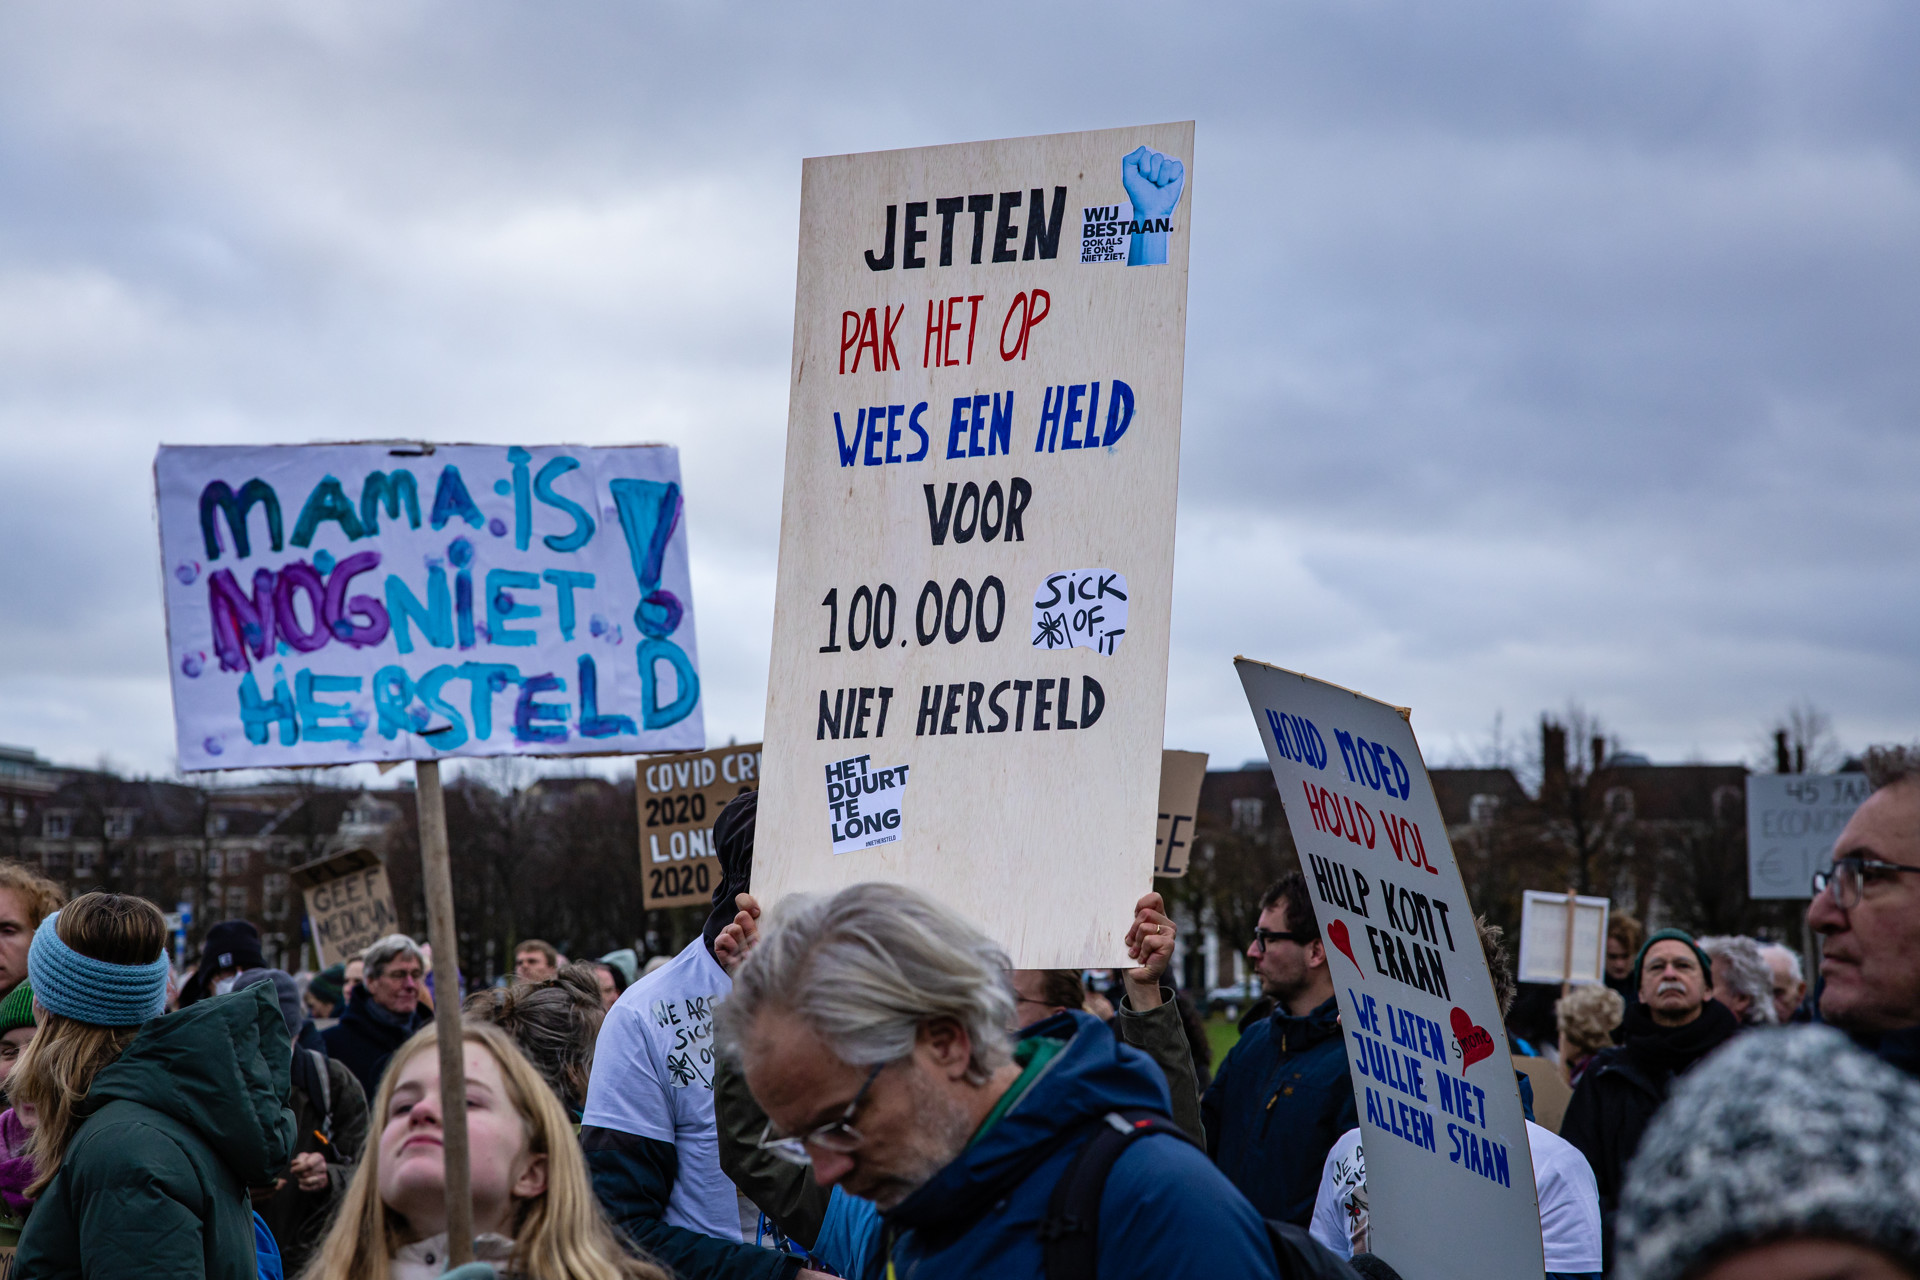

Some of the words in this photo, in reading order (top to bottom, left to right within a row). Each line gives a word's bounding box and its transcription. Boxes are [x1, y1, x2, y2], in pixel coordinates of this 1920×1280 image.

[864, 185, 1067, 271] JETTEN
[1083, 218, 1174, 238] BESTAAN.
[1084, 206, 1119, 222] WIJ
[1081, 254, 1102, 262] NIET
[1104, 252, 1125, 260] ZIET.
[1082, 239, 1104, 247] OOK
[1105, 237, 1123, 246] ALS
[1082, 247, 1092, 255] JE
[1094, 246, 1114, 254] ONS
[839, 302, 905, 375] PAK
[923, 294, 984, 368] HET
[1000, 288, 1051, 362] OP
[833, 401, 929, 468] WEES
[946, 390, 1014, 460] EEN
[1035, 379, 1135, 454] HELD
[198, 464, 485, 562] MAMA
[923, 476, 1033, 546] VOOR
[208, 551, 391, 673] NOG
[818, 575, 1006, 653] 100.000
[1073, 605, 1105, 637] OF
[237, 638, 700, 752] HERSTELD
[816, 686, 894, 741] NIET
[915, 675, 1106, 737] HERSTELD
[645, 757, 716, 793] COVID
[825, 754, 871, 784] HET
[1265, 708, 1328, 771] HOUD
[1333, 728, 1410, 801] MOED
[827, 764, 909, 803] DUURT
[1785, 781, 1819, 805] 45
[646, 793, 706, 827] 2020
[829, 798, 860, 822] TE
[832, 808, 901, 843] LONG
[1302, 780, 1376, 850] HOUD
[1379, 810, 1438, 875] VOL
[313, 868, 380, 912] GEEF
[650, 863, 710, 899] 2020
[1308, 853, 1370, 918] HULP
[1380, 879, 1455, 952] KOMT
[1365, 924, 1451, 1002] ERAAN
[650, 1000, 681, 1028] WE
[1348, 988, 1382, 1037] WE
[1386, 1003, 1447, 1066] LATEN
[1351, 1030, 1428, 1103] JULLIE
[1436, 1069, 1486, 1130] NIET
[1365, 1086, 1436, 1154] ALLEEN
[1447, 1122, 1511, 1189] STAAN
[1332, 1157, 1351, 1186] WE
